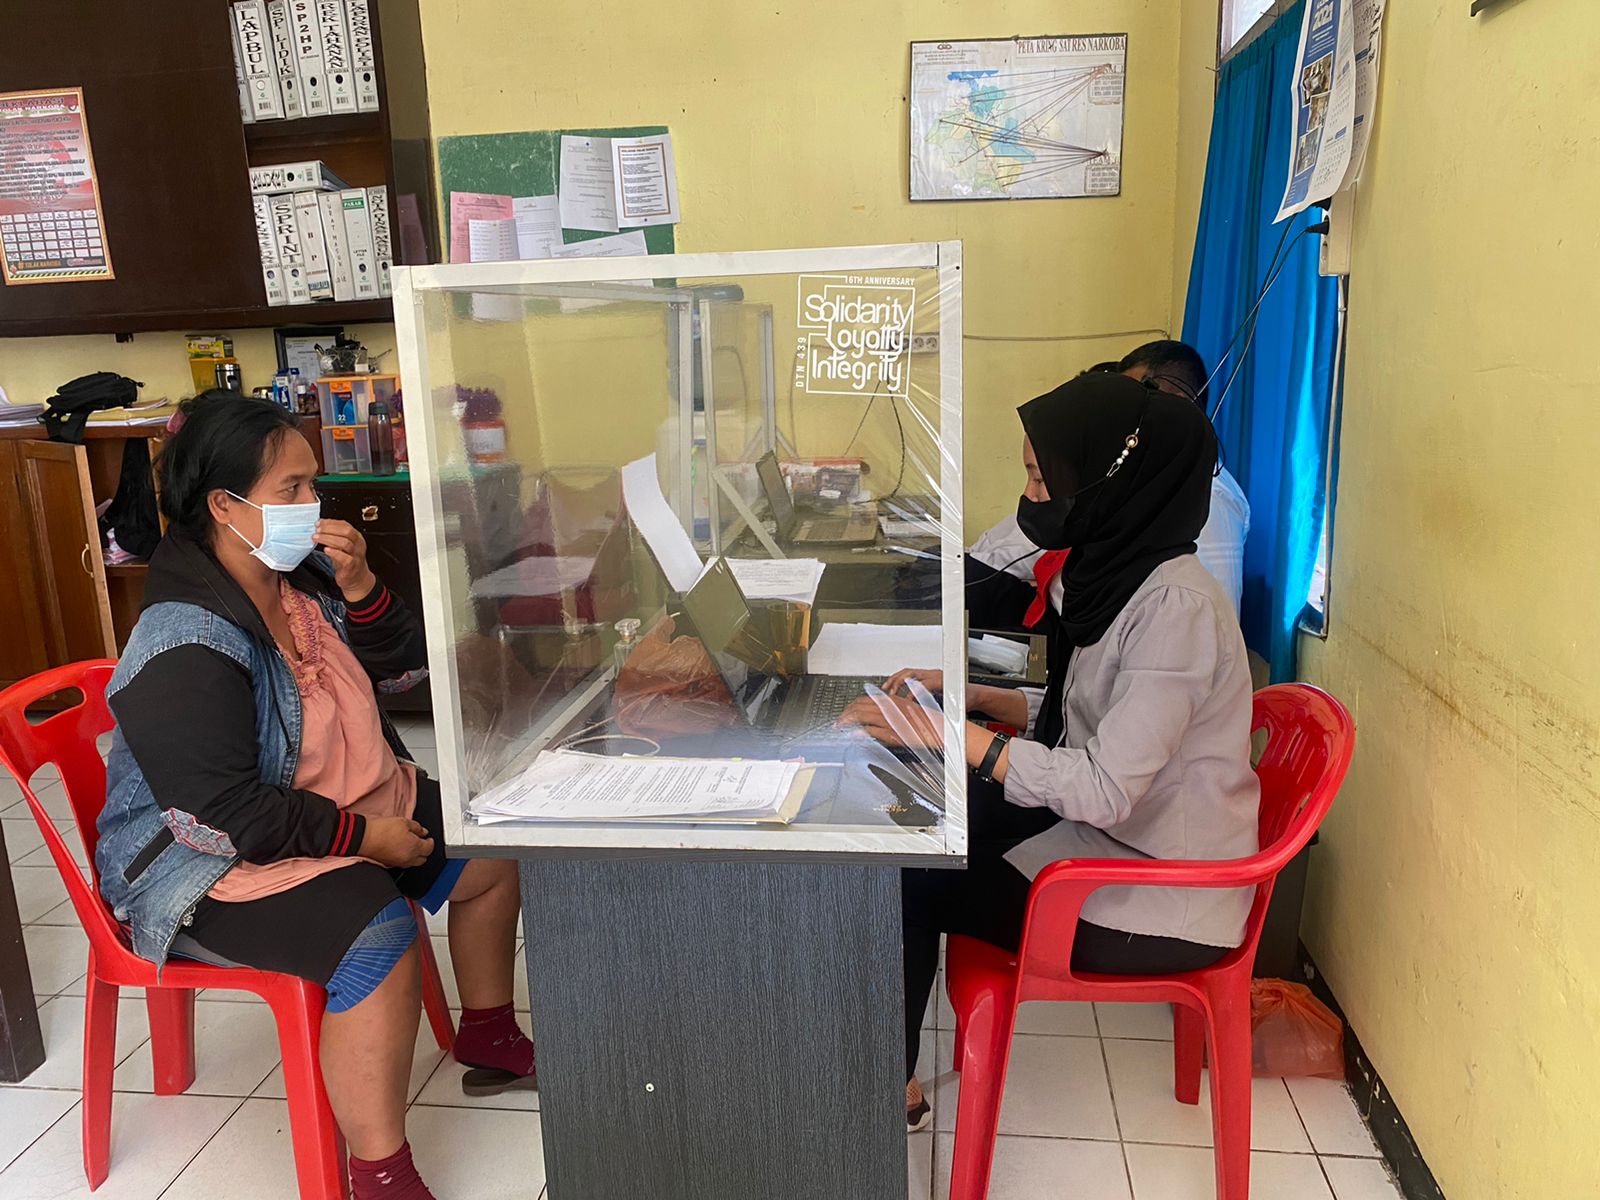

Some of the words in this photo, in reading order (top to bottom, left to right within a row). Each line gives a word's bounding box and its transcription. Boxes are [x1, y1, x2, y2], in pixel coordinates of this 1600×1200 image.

[240, 10, 264, 74] LAPBUL
[295, 2, 313, 54] SP2HP
[1088, 37, 1125, 51] NARKOBA
[276, 34, 291, 76] LIDIK
[275, 204, 300, 263] SPRINT
[864, 276, 915, 286] ANNIVERSARY
[805, 294, 913, 331] Solidarity
[797, 337, 807, 360] 439
[825, 322, 905, 359] Loyalty
[812, 348, 903, 391] Integrity
